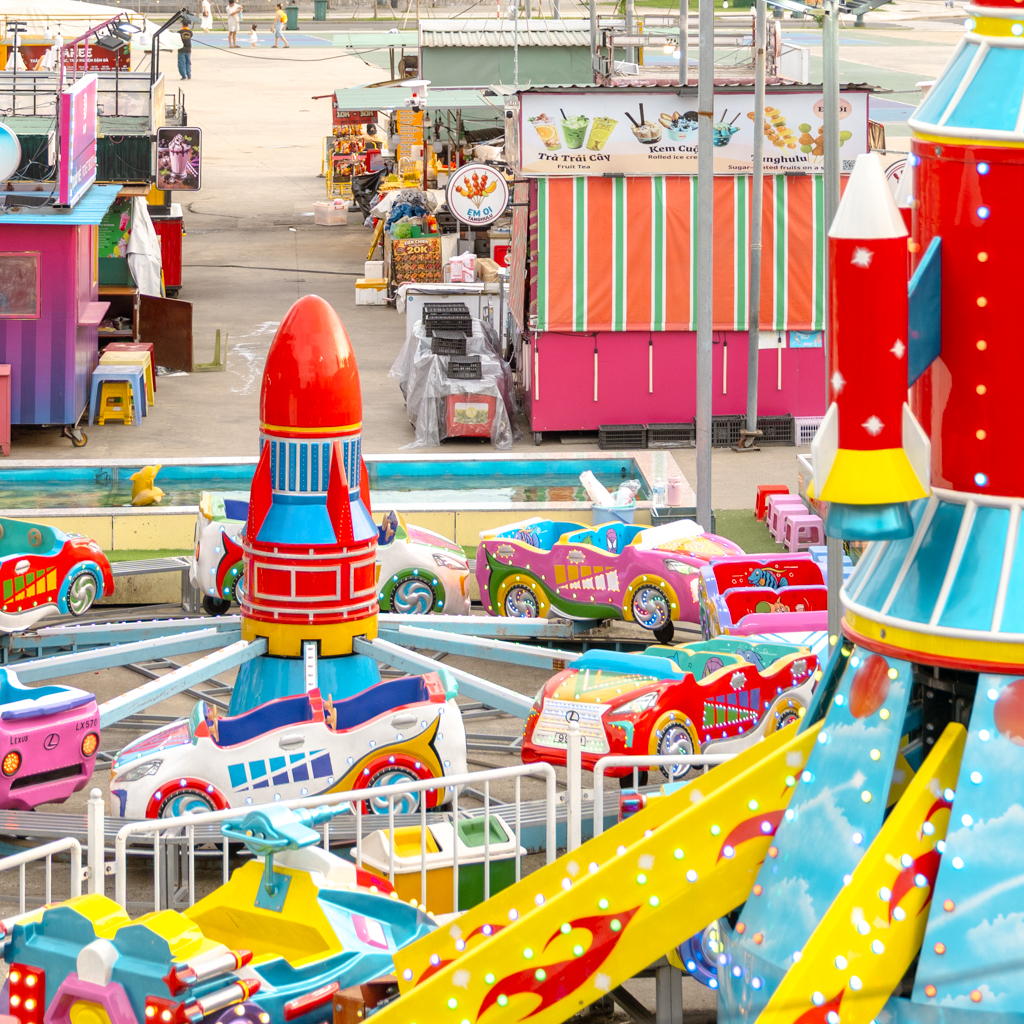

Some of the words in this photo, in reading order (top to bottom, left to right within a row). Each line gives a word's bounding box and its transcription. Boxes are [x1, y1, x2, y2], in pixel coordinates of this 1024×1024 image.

[649, 145, 676, 153] Kem
[678, 144, 699, 154] Cuộ
[538, 152, 558, 162] Trà
[561, 153, 587, 162] Trái
[589, 153, 611, 162] Cây
[406, 246, 428, 254] 20K
[75, 719, 98, 731] LX570
